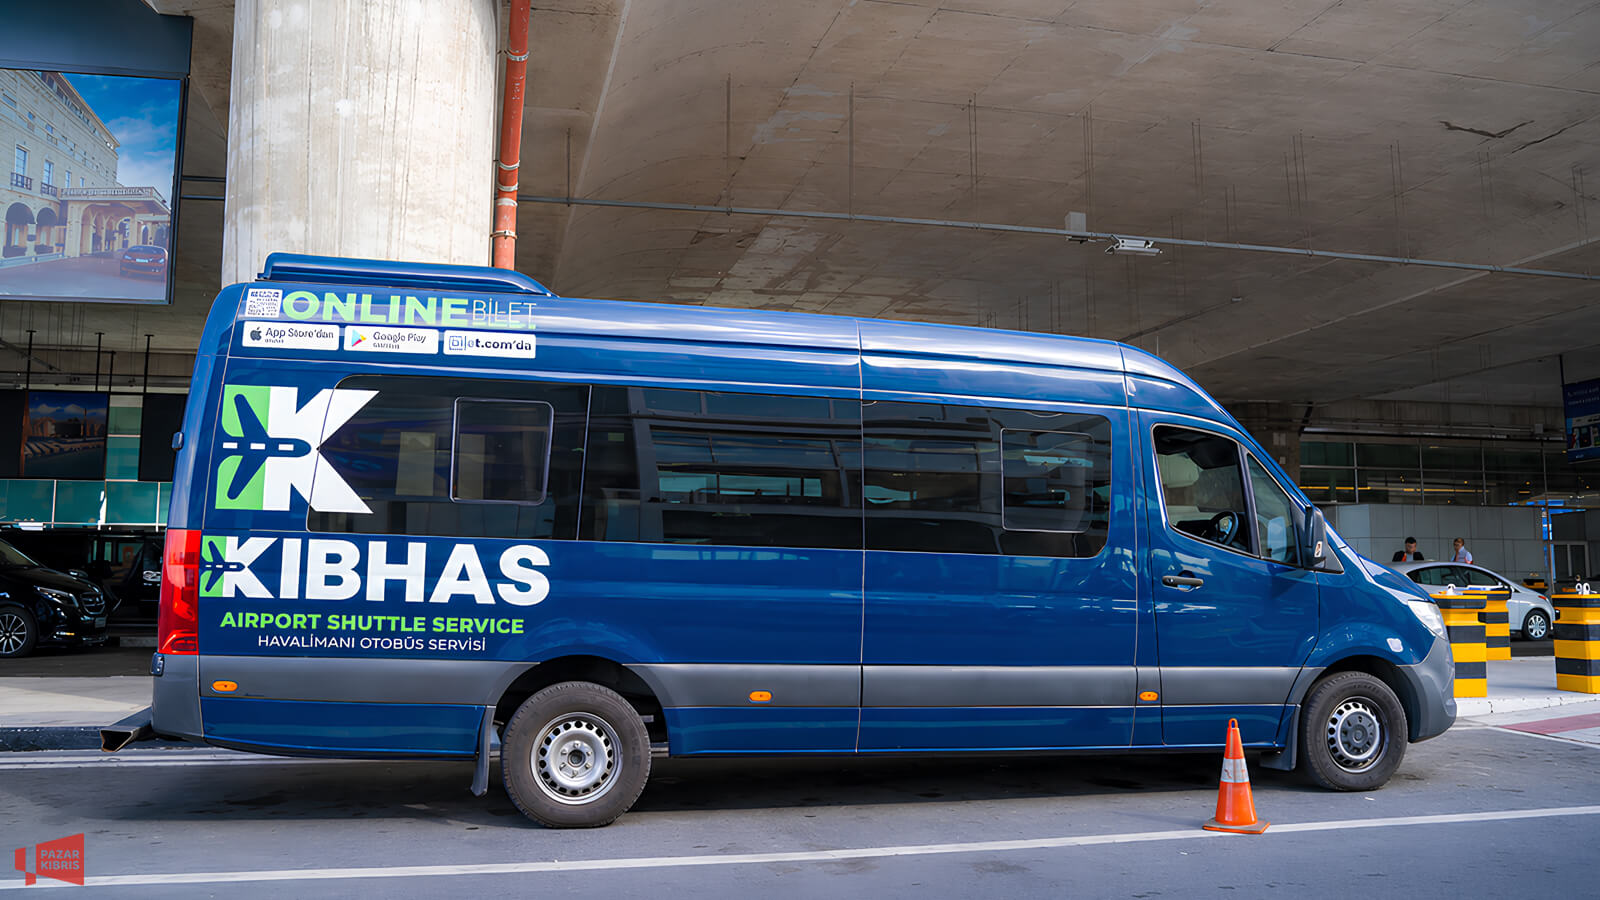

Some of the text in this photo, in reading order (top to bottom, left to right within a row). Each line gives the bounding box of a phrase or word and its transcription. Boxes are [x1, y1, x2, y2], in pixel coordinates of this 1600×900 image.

[282, 290, 469, 326] ONLINE
[265, 327, 286, 339] App
[372, 331, 427, 344] Google Play
[200, 535, 551, 606] KIBHAS
[220, 612, 524, 634] AIRPORT SHUTTLE SERVICE
[428, 637, 486, 651] SERVİSİ
